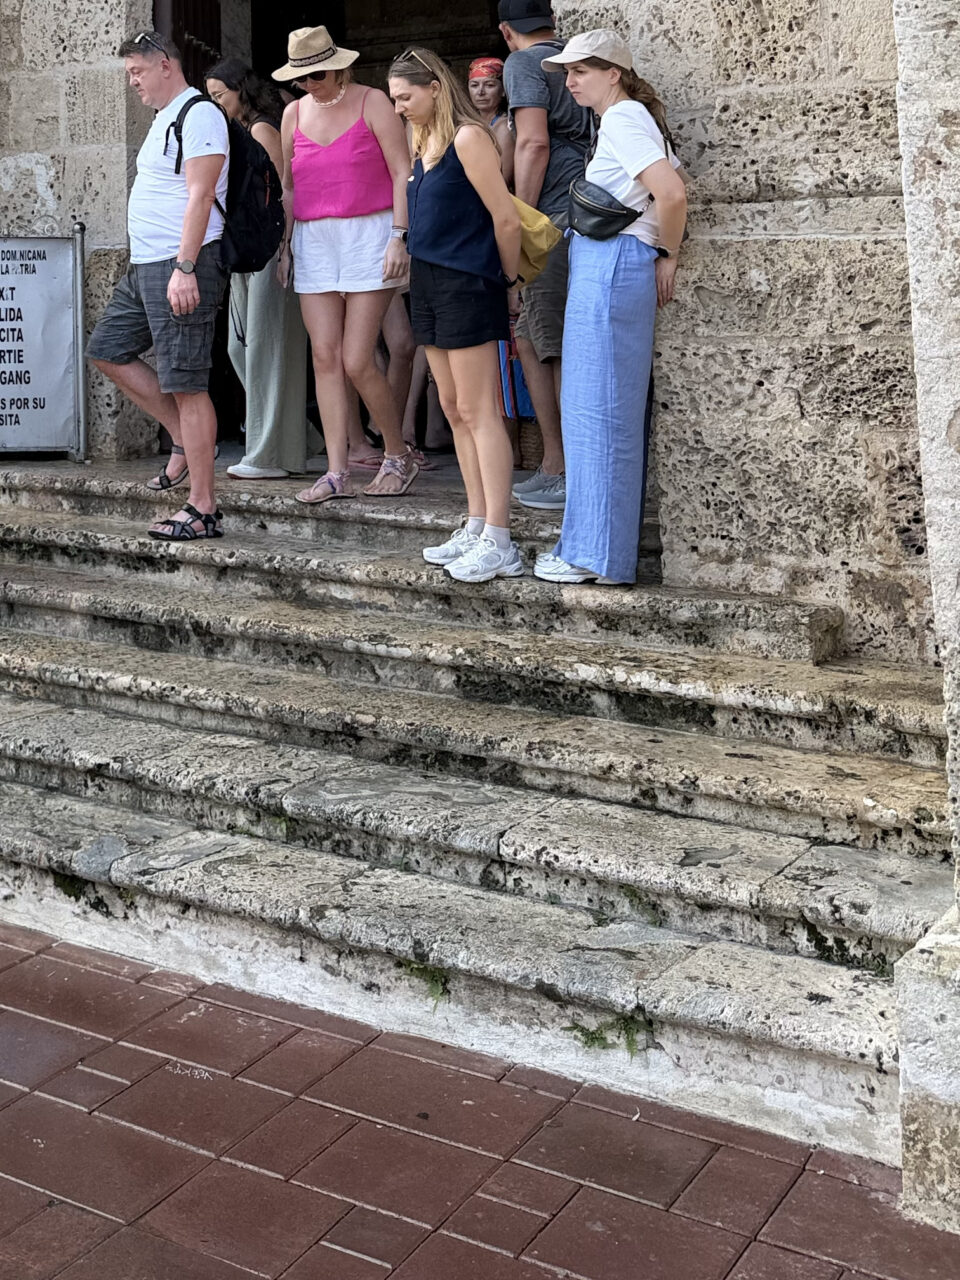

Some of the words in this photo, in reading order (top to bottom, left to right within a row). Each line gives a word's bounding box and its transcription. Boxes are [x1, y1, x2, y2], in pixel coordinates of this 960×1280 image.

[0, 249, 47, 262] DOMNICANA
[0, 263, 10, 275] LA
[11, 263, 37, 275] TRIA
[9, 398, 30, 410] POR
[32, 397, 46, 410] SU
